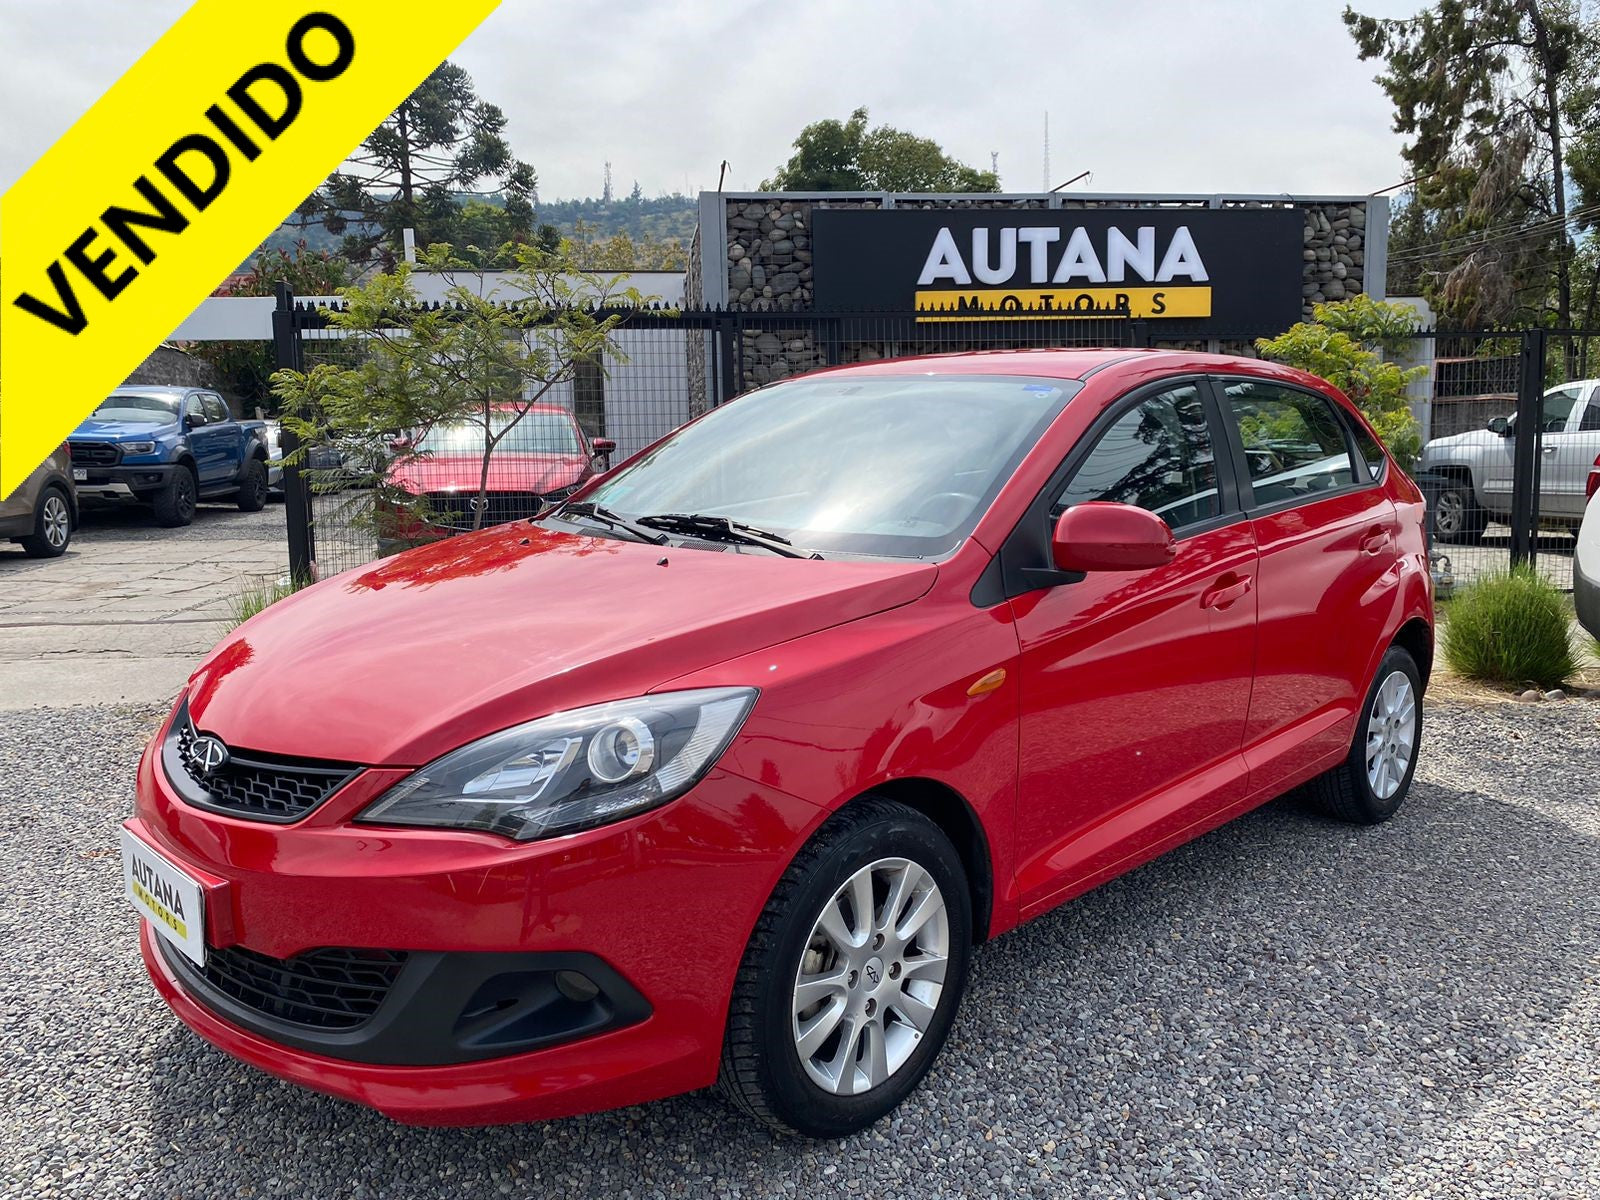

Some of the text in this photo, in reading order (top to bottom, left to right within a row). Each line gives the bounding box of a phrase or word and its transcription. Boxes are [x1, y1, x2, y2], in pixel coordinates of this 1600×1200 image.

[917, 226, 1210, 285] AUTANA
[957, 293, 1166, 315] MOTORS
[132, 853, 185, 921] AUTANA
[138, 887, 177, 930] MOTORS
